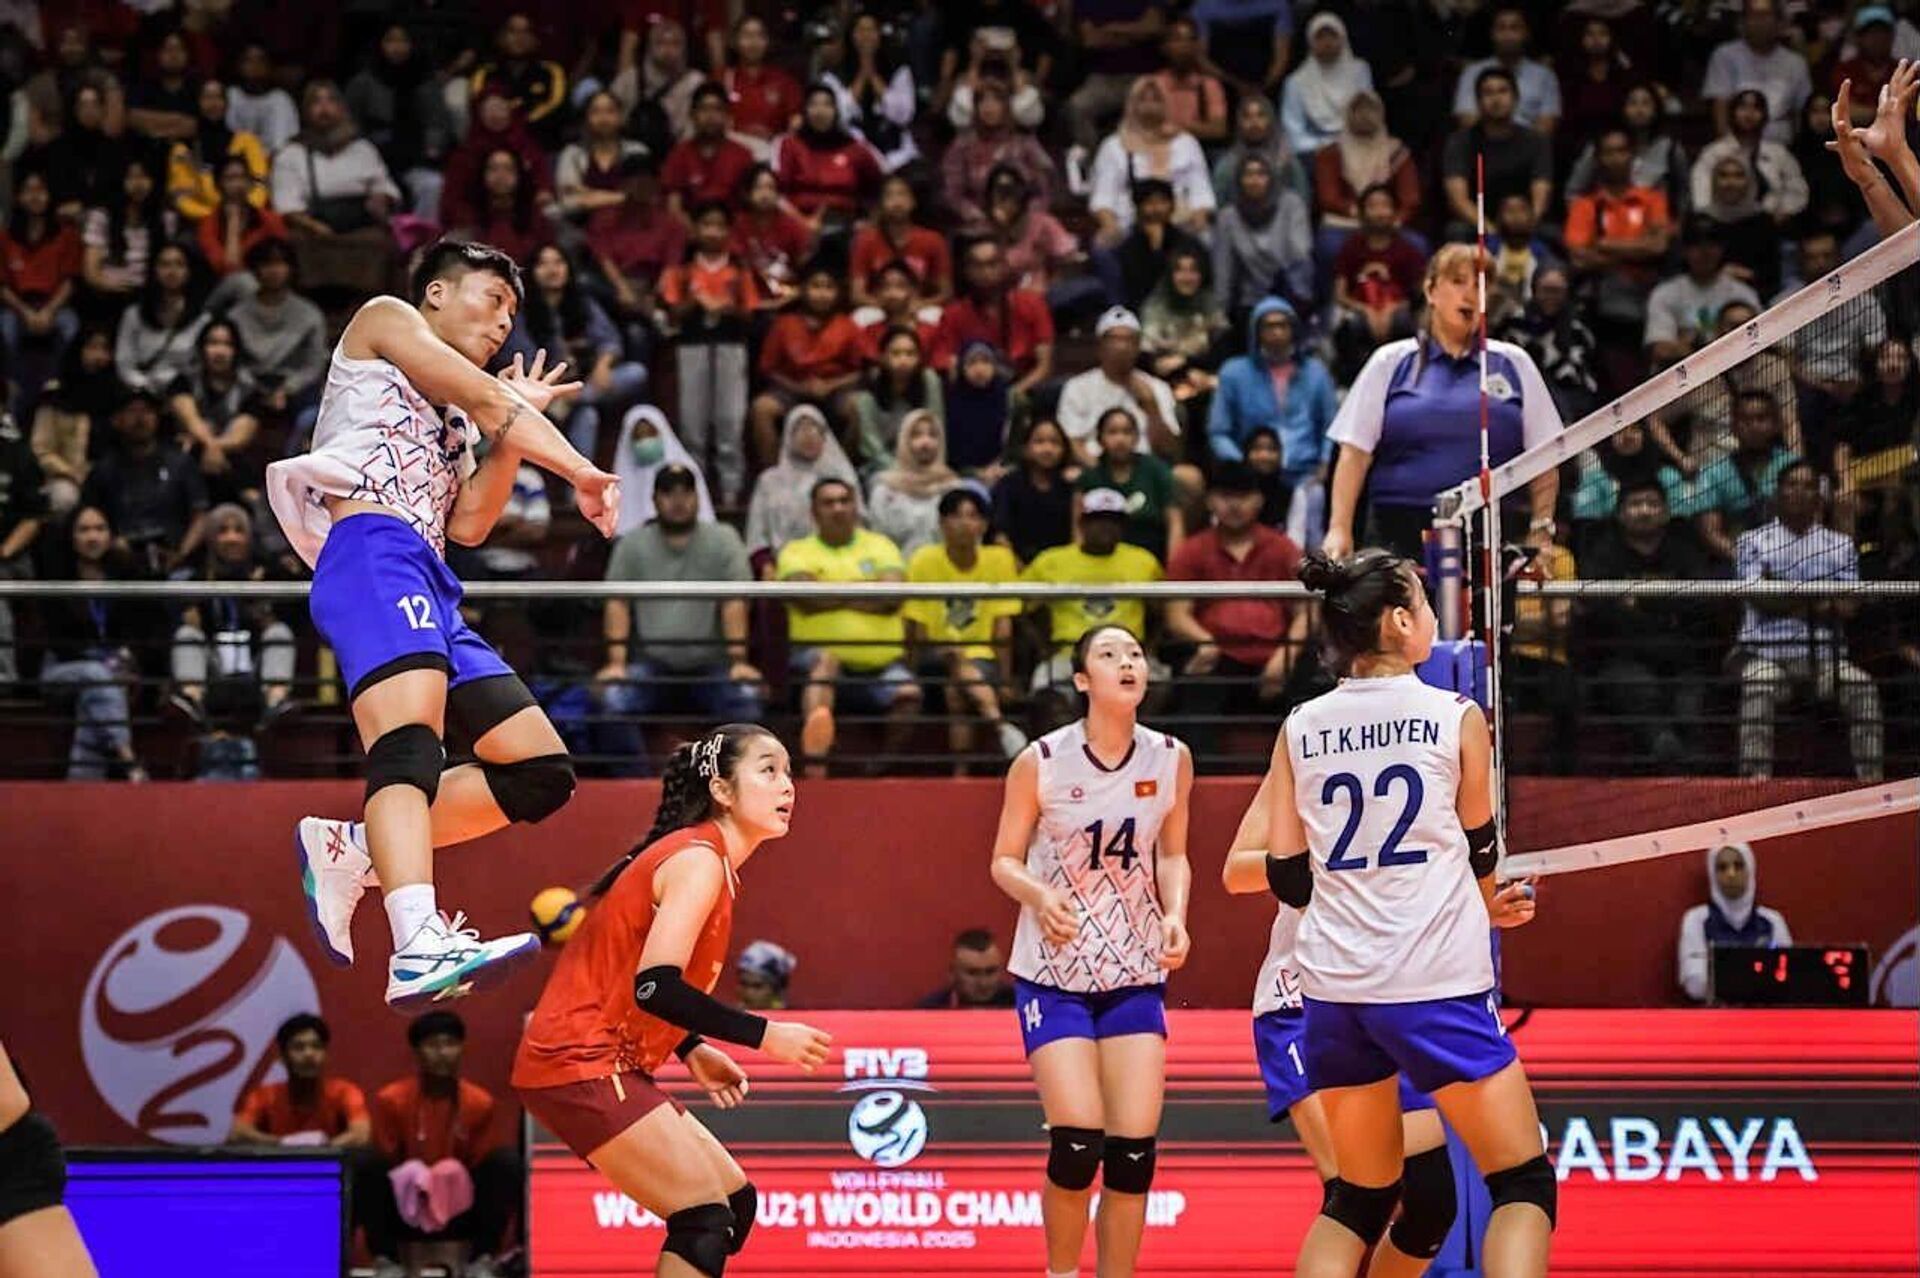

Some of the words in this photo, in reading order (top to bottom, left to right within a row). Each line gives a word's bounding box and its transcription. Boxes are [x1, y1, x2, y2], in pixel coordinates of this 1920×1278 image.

[396, 594, 436, 630] 12
[1302, 718, 1439, 759] L.T.K.HUYEN
[1321, 763, 1428, 872] 22
[1085, 817, 1138, 870] 14
[1024, 998, 1043, 1032] 14
[844, 1047, 928, 1078] FIVB
[1540, 1117, 1819, 1182] ABAYA
[756, 1191, 816, 1227] U21
[819, 1191, 942, 1227] WORLD
